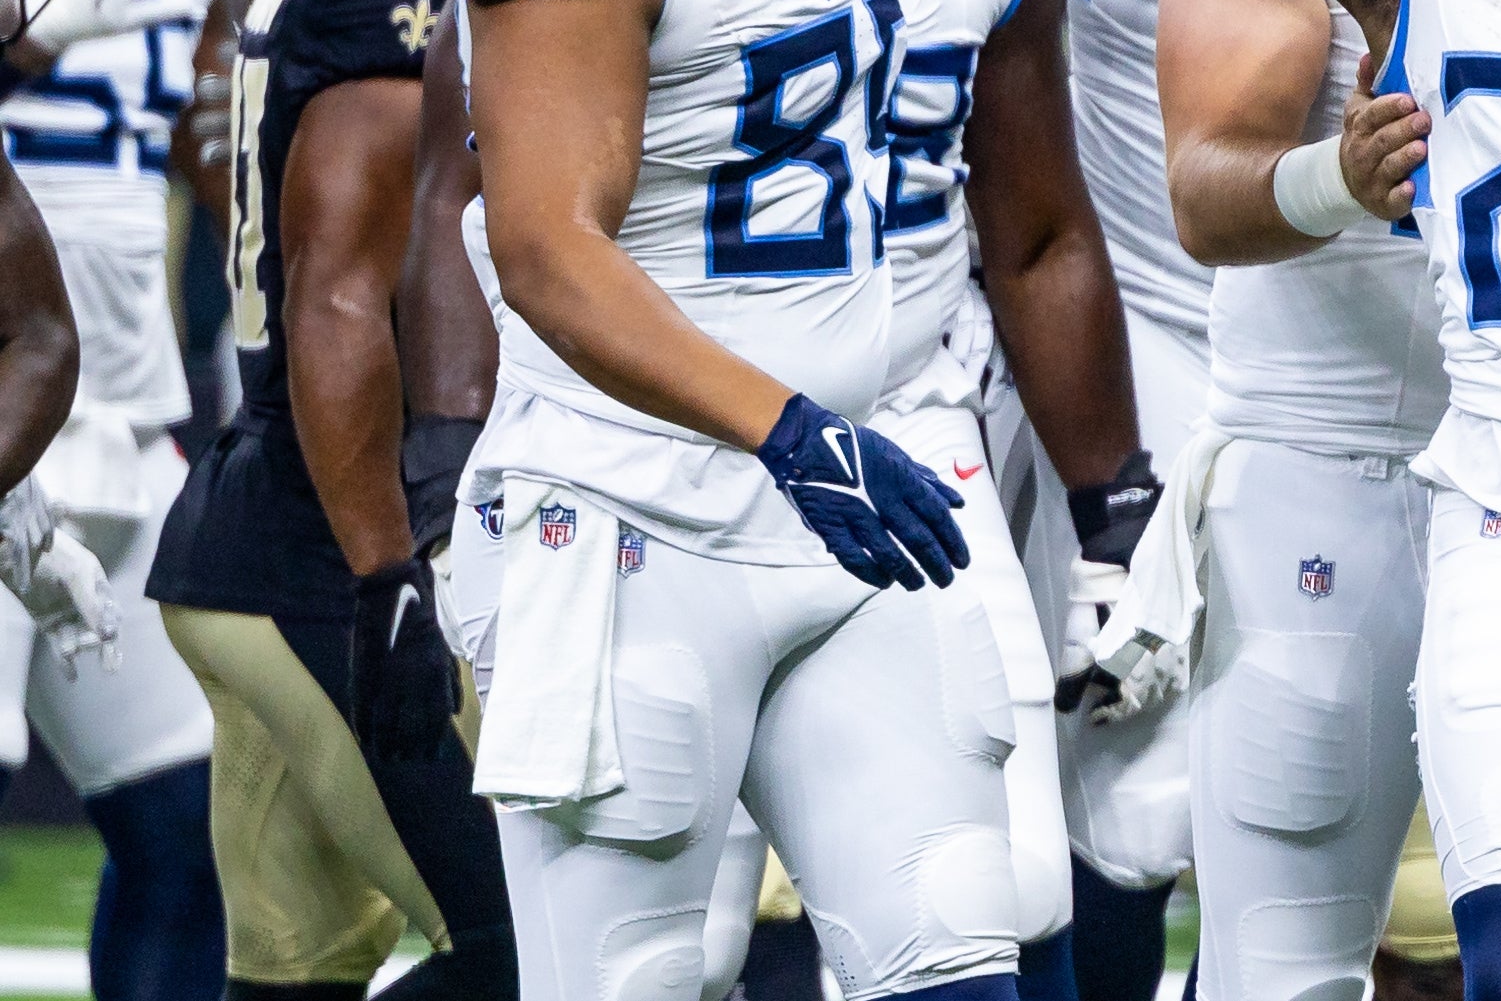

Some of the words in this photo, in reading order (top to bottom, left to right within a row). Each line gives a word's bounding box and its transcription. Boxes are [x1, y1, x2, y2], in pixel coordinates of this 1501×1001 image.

[542, 523, 571, 546] NFL
[617, 551, 639, 569] NFL
[1304, 573, 1328, 592] NFL
